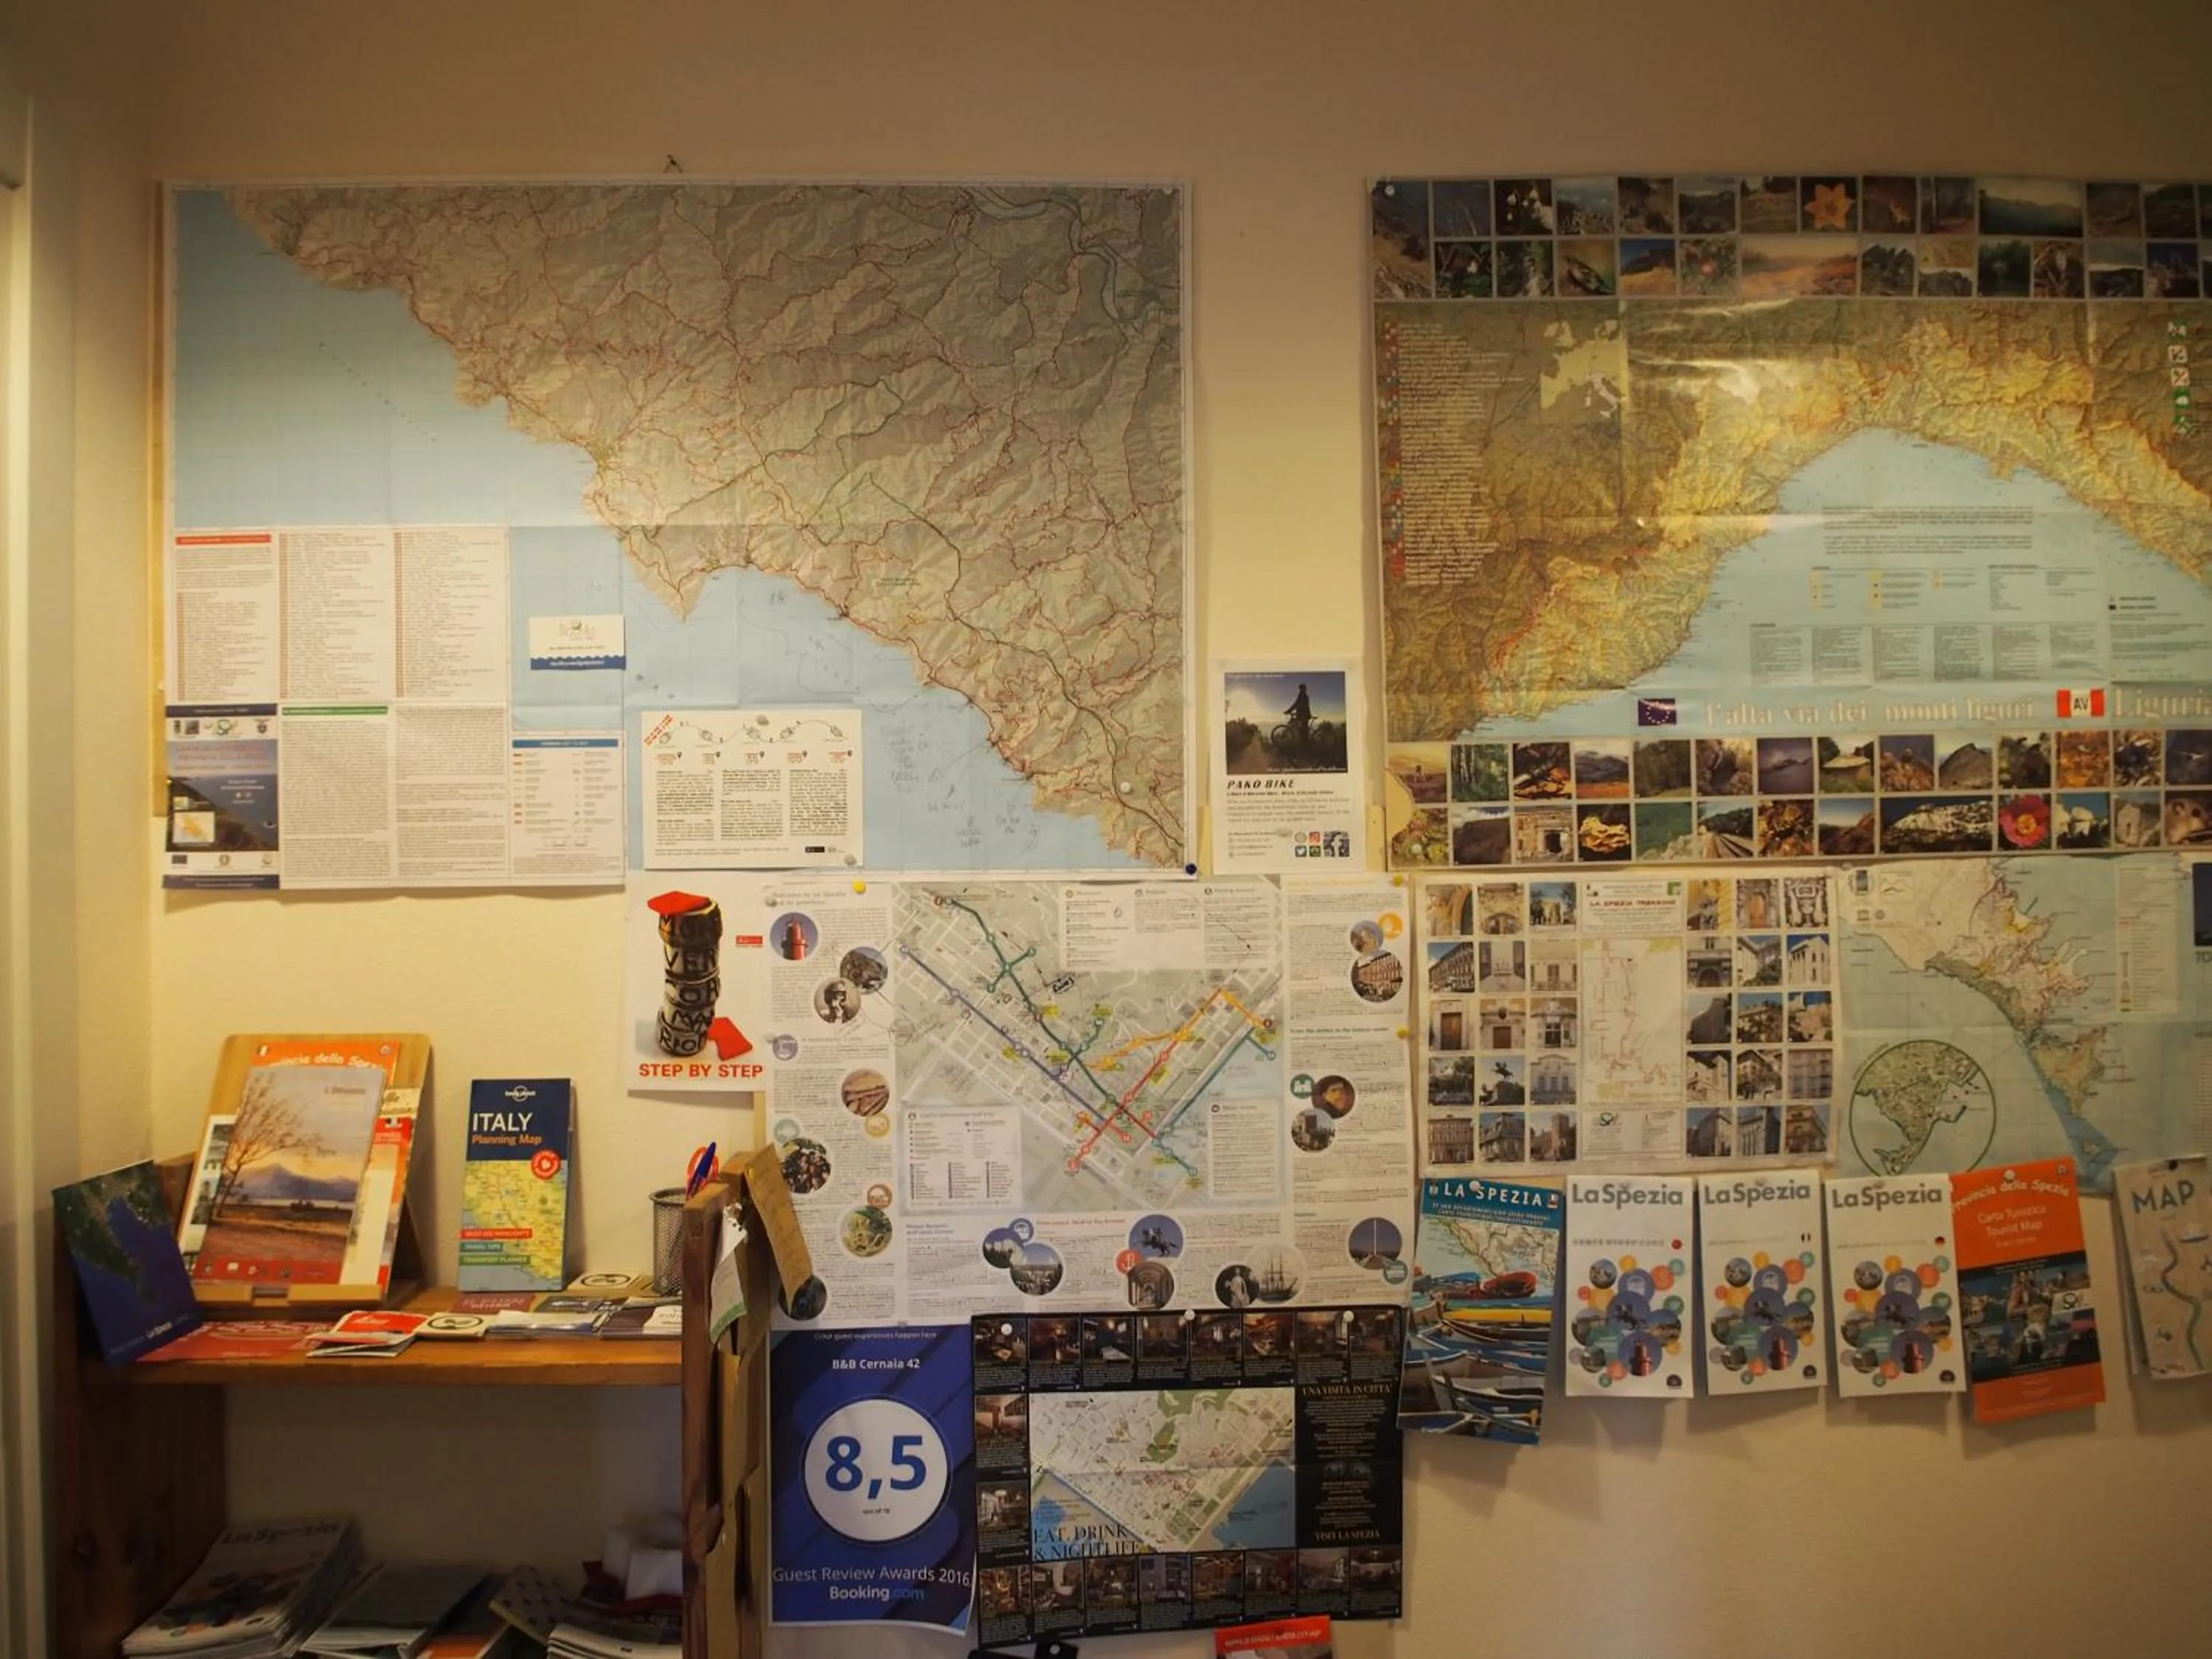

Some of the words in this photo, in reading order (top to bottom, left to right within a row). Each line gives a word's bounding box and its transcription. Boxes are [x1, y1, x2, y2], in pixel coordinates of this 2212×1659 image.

[2073, 695, 2090, 712] AV
[1265, 778, 1296, 789] BIKE
[639, 1063, 684, 1077] STEP
[689, 1063, 712, 1078] BY
[719, 1064, 764, 1078] STEP
[473, 1112, 534, 1132] ITALY
[473, 1135, 517, 1147] Planning
[519, 1135, 543, 1146] Map
[1444, 1181, 1465, 1198] LA
[1476, 1186, 1543, 1207] SPEZIA
[2131, 1180, 2195, 1214] MAP
[832, 1359, 856, 1370] B&B
[859, 1359, 905, 1370] Cernaia
[906, 1357, 921, 1369] 42
[825, 1435, 927, 1500] 8,5
[773, 1567, 817, 1582] Guest
[822, 1566, 876, 1581] Review
[880, 1565, 935, 1582] Awards
[829, 1585, 926, 1601] Booking.com
